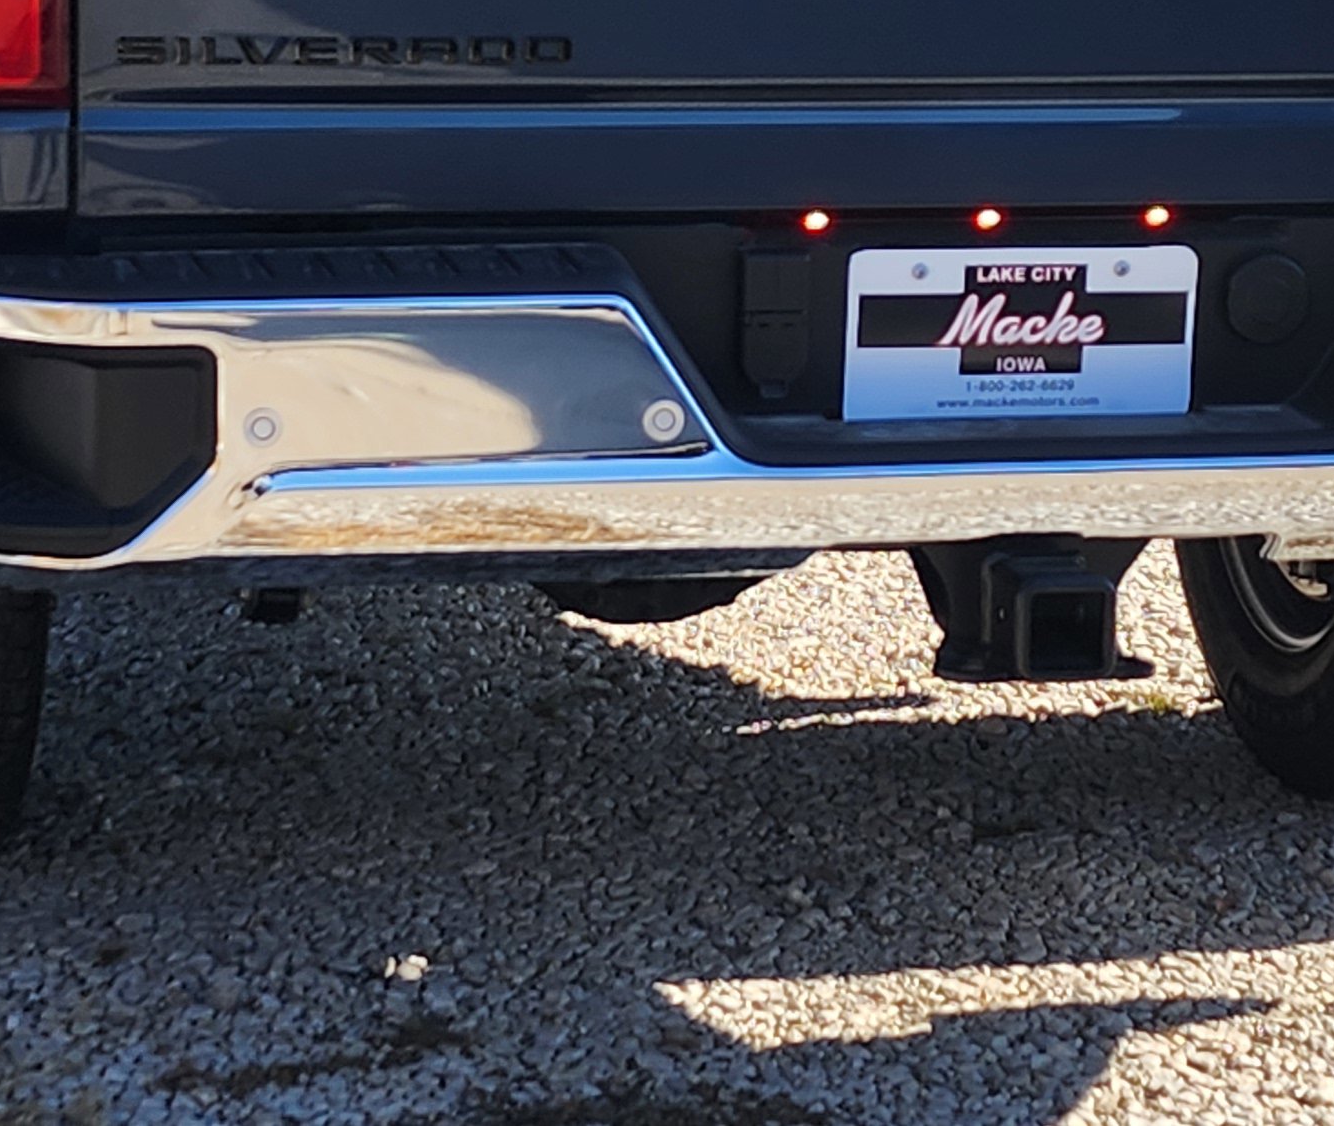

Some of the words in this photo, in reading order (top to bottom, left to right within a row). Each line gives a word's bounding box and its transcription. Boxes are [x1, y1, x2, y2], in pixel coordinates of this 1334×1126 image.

[116, 35, 573, 66] SILVERADO
[976, 266, 1026, 283] LAKE
[1031, 265, 1077, 282] CITY
[939, 290, 1105, 345] Macke
[996, 356, 1047, 372] IOWA
[936, 396, 1100, 408] www.mackemotors.com
